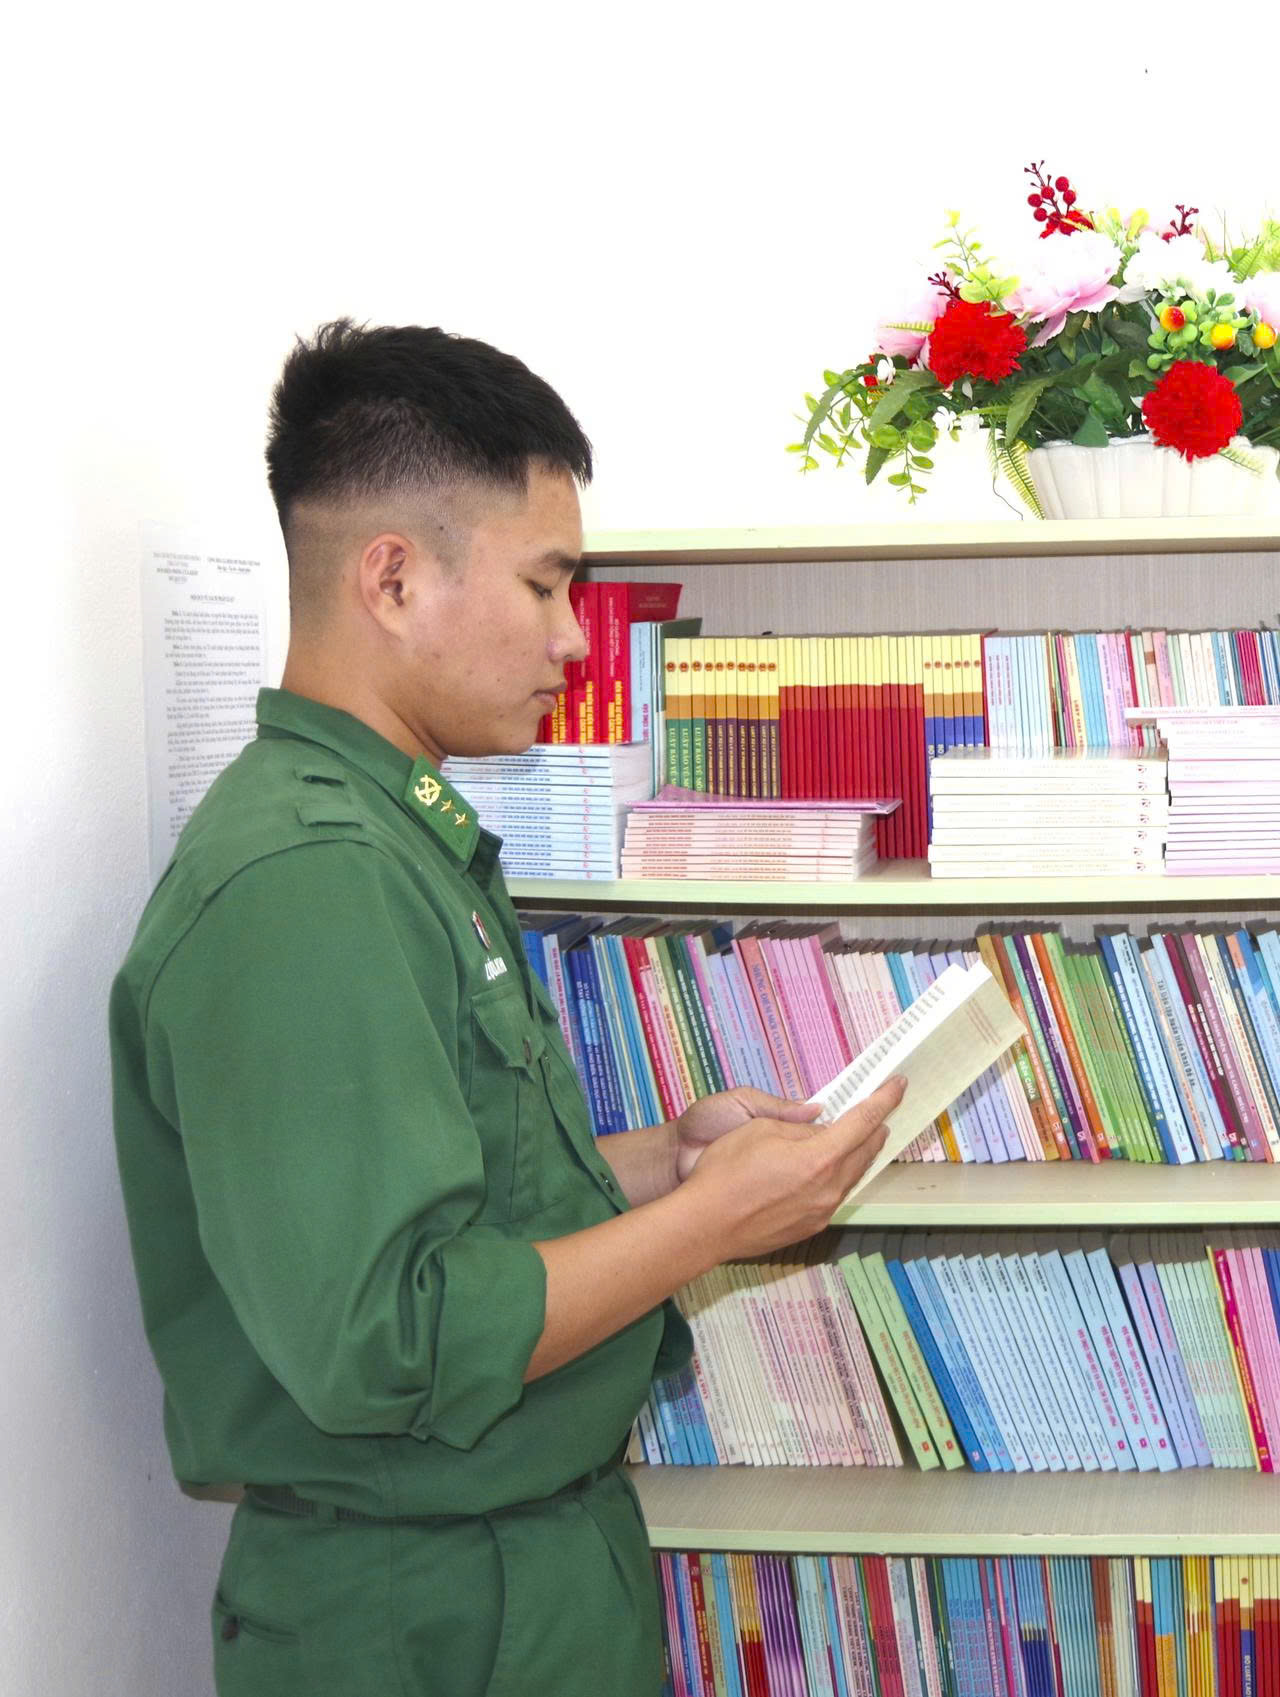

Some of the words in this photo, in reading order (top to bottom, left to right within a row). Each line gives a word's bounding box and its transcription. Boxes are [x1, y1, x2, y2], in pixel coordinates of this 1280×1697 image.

[683, 766, 689, 775] VỆ
[695, 764, 701, 775] VỆ
[1244, 1655, 1250, 1664] BỘ
